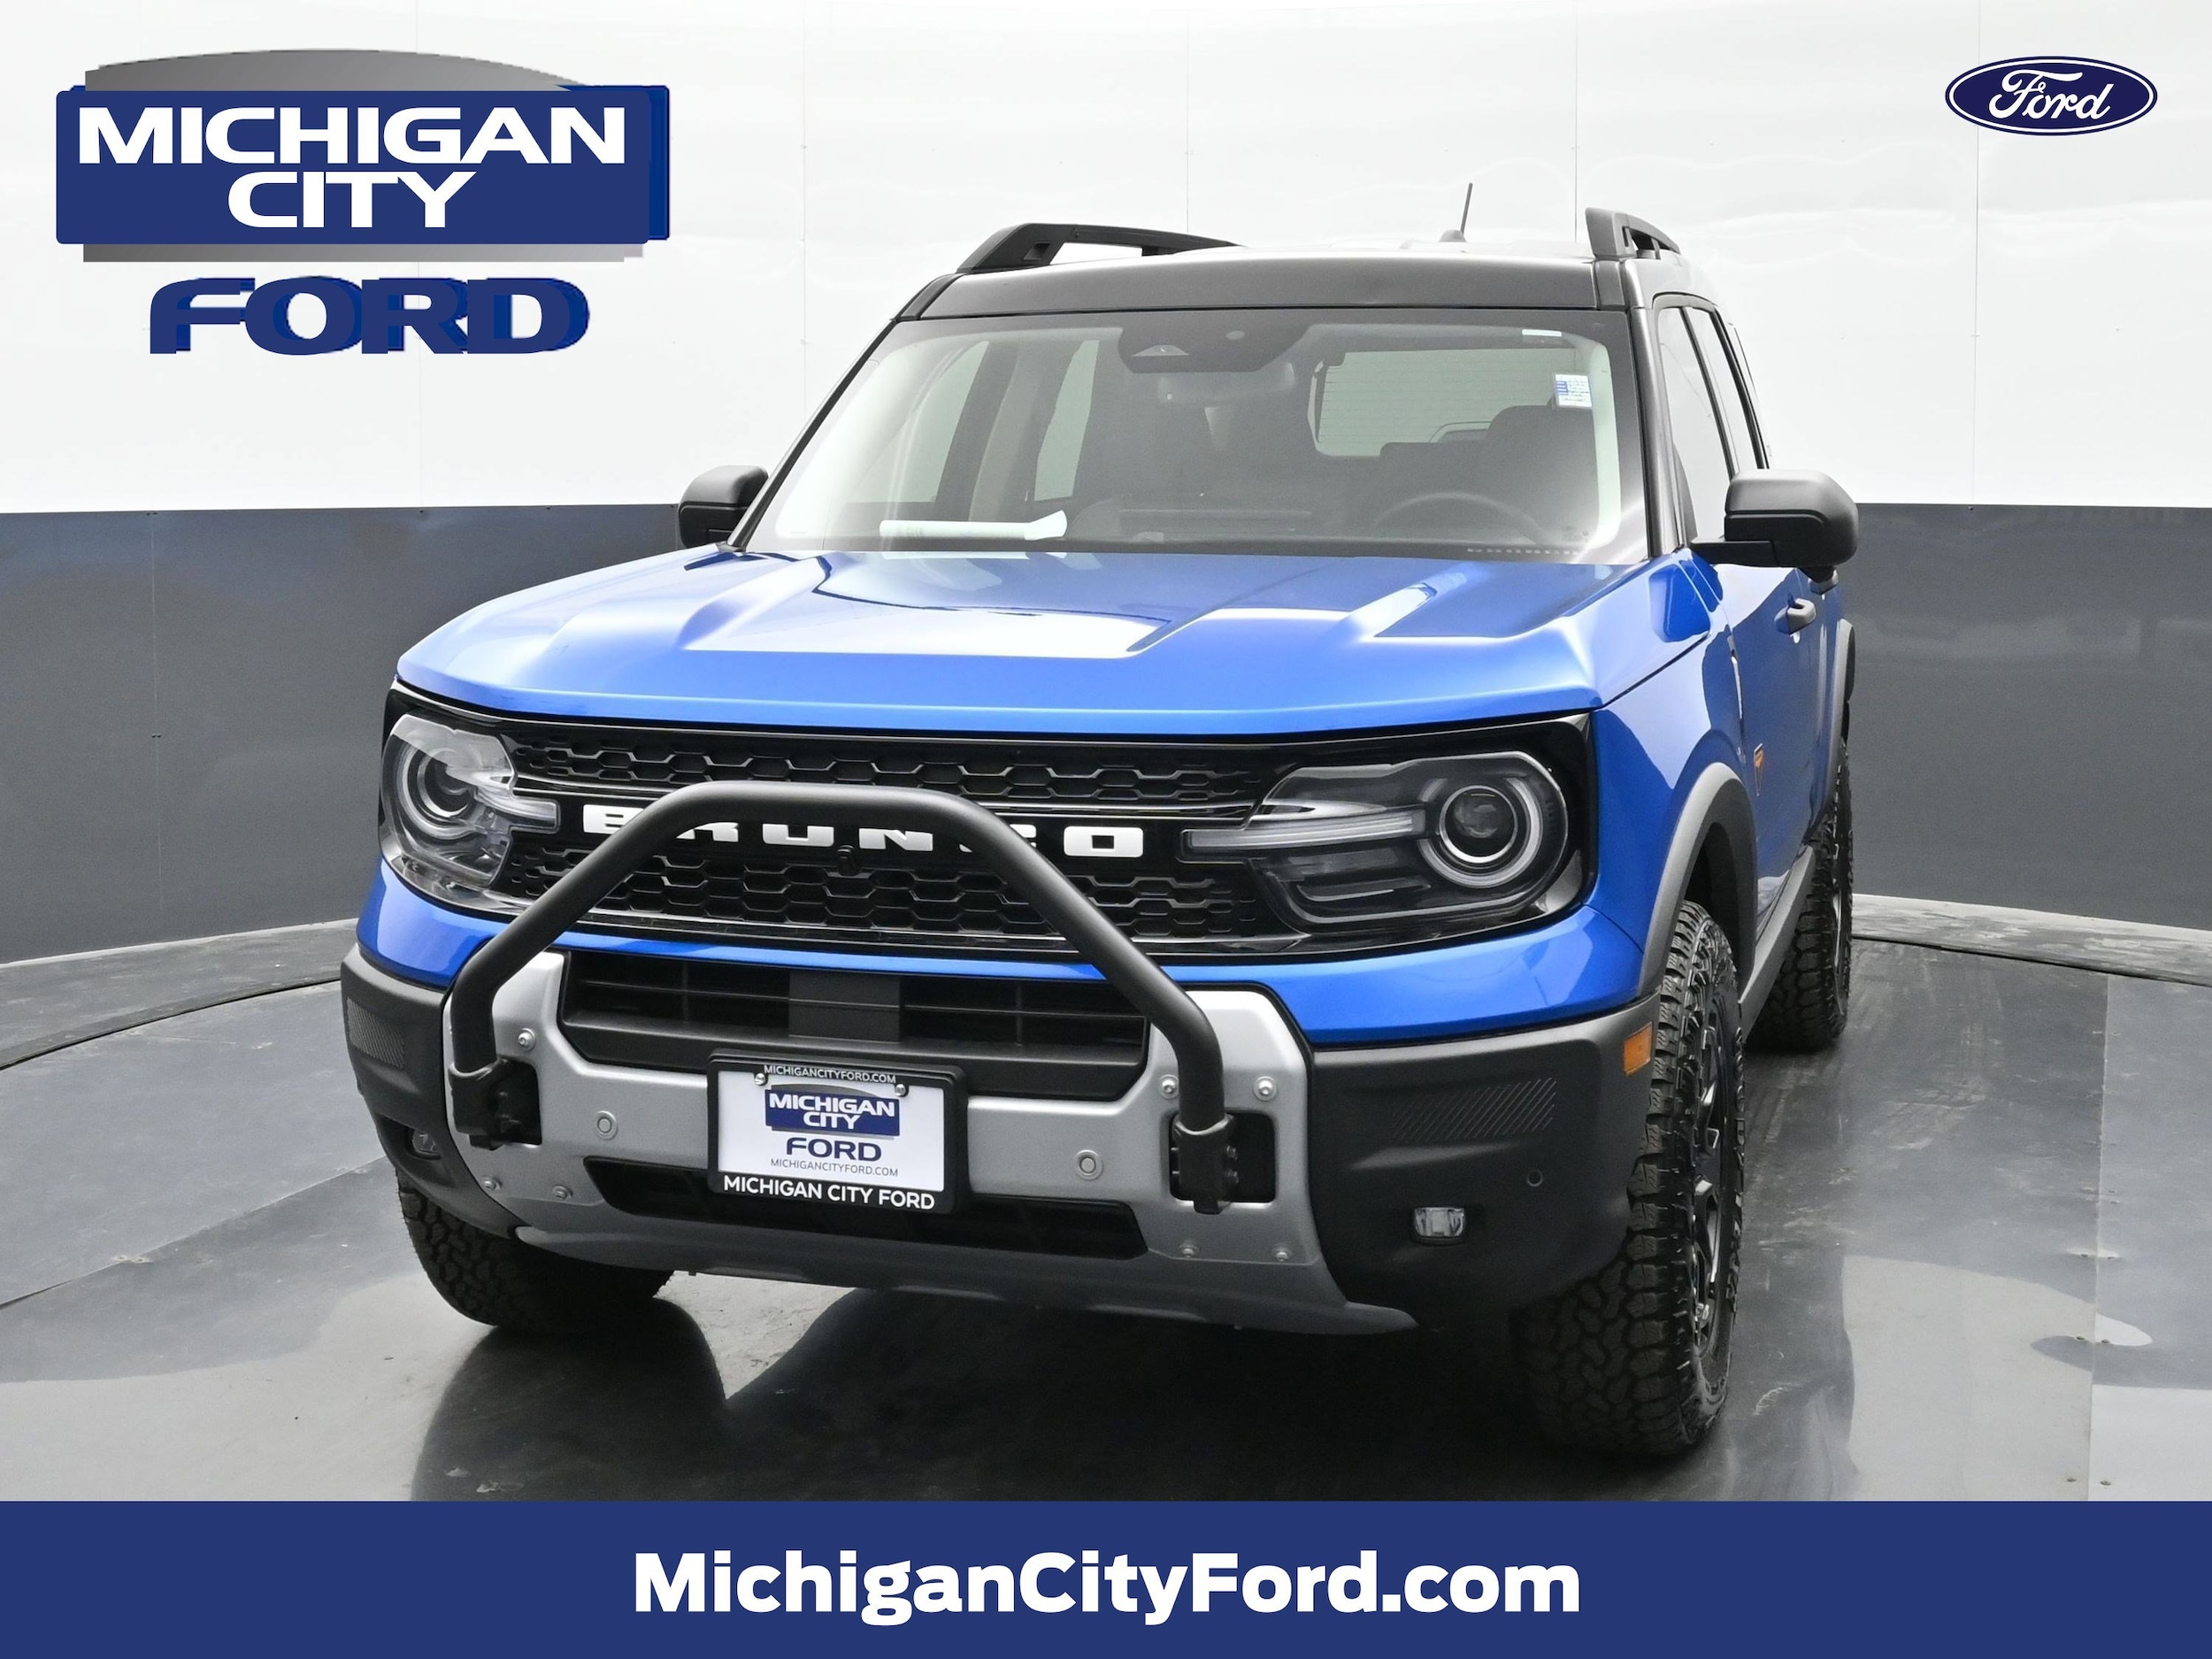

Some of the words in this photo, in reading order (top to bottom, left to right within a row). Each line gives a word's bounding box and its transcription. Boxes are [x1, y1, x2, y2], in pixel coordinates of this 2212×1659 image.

[764, 1064, 896, 1084] MICHIGANCITYFORD.COM
[769, 1093, 895, 1117] MICHIGAN
[803, 1111, 862, 1130] CITY
[787, 1137, 882, 1162] FORD
[771, 1158, 898, 1177] MICHIGANCITYFORD.COM
[724, 1175, 823, 1200] MICHIGAN
[827, 1185, 873, 1204] CITY
[879, 1188, 935, 1210] FORD
